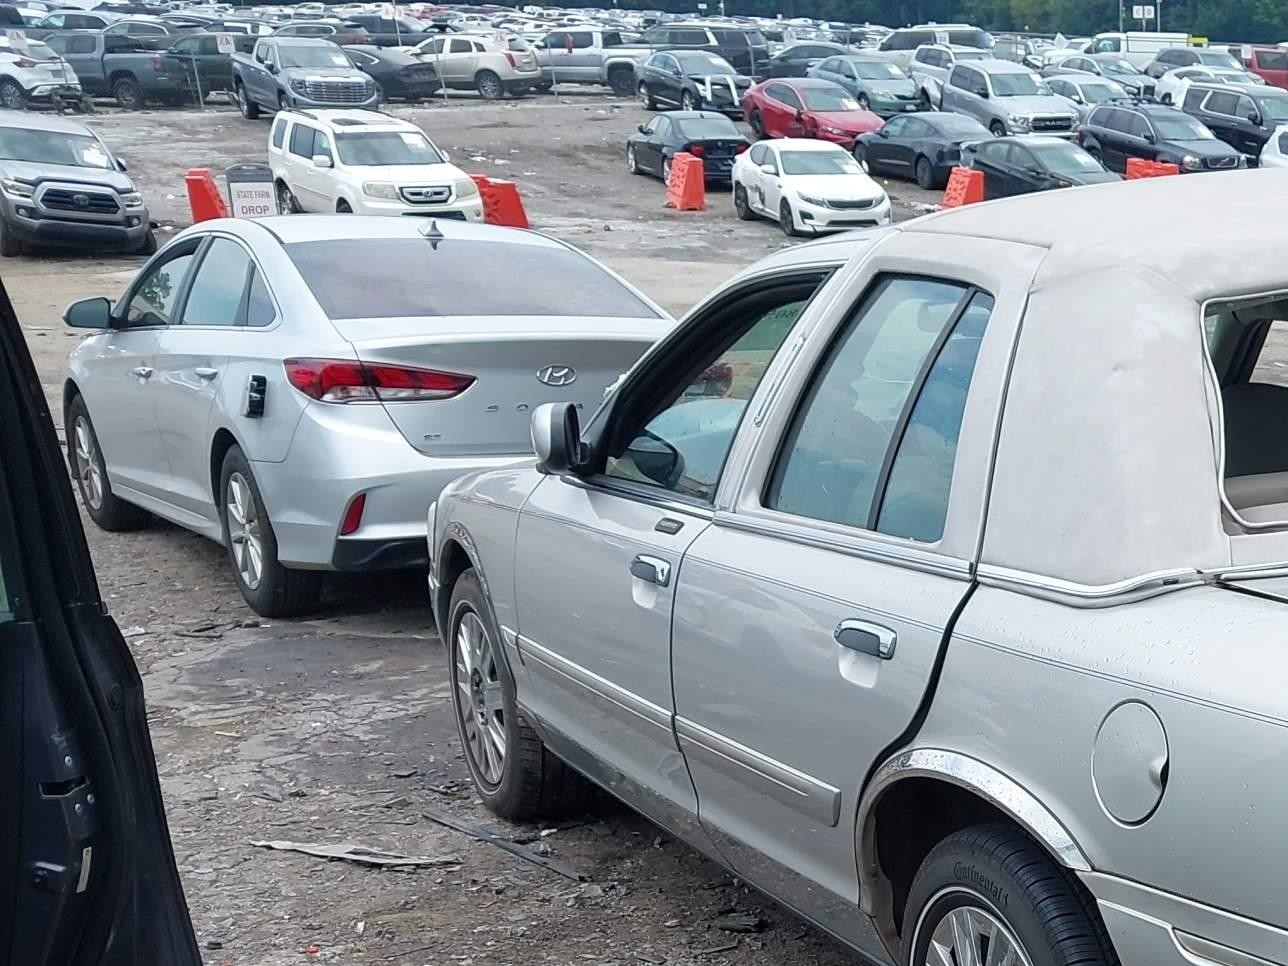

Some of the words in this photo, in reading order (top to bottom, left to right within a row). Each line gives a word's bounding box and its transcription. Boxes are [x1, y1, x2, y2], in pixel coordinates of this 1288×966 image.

[237, 191, 253, 199] STATE
[255, 190, 270, 199] FARM
[241, 205, 269, 214] DROP
